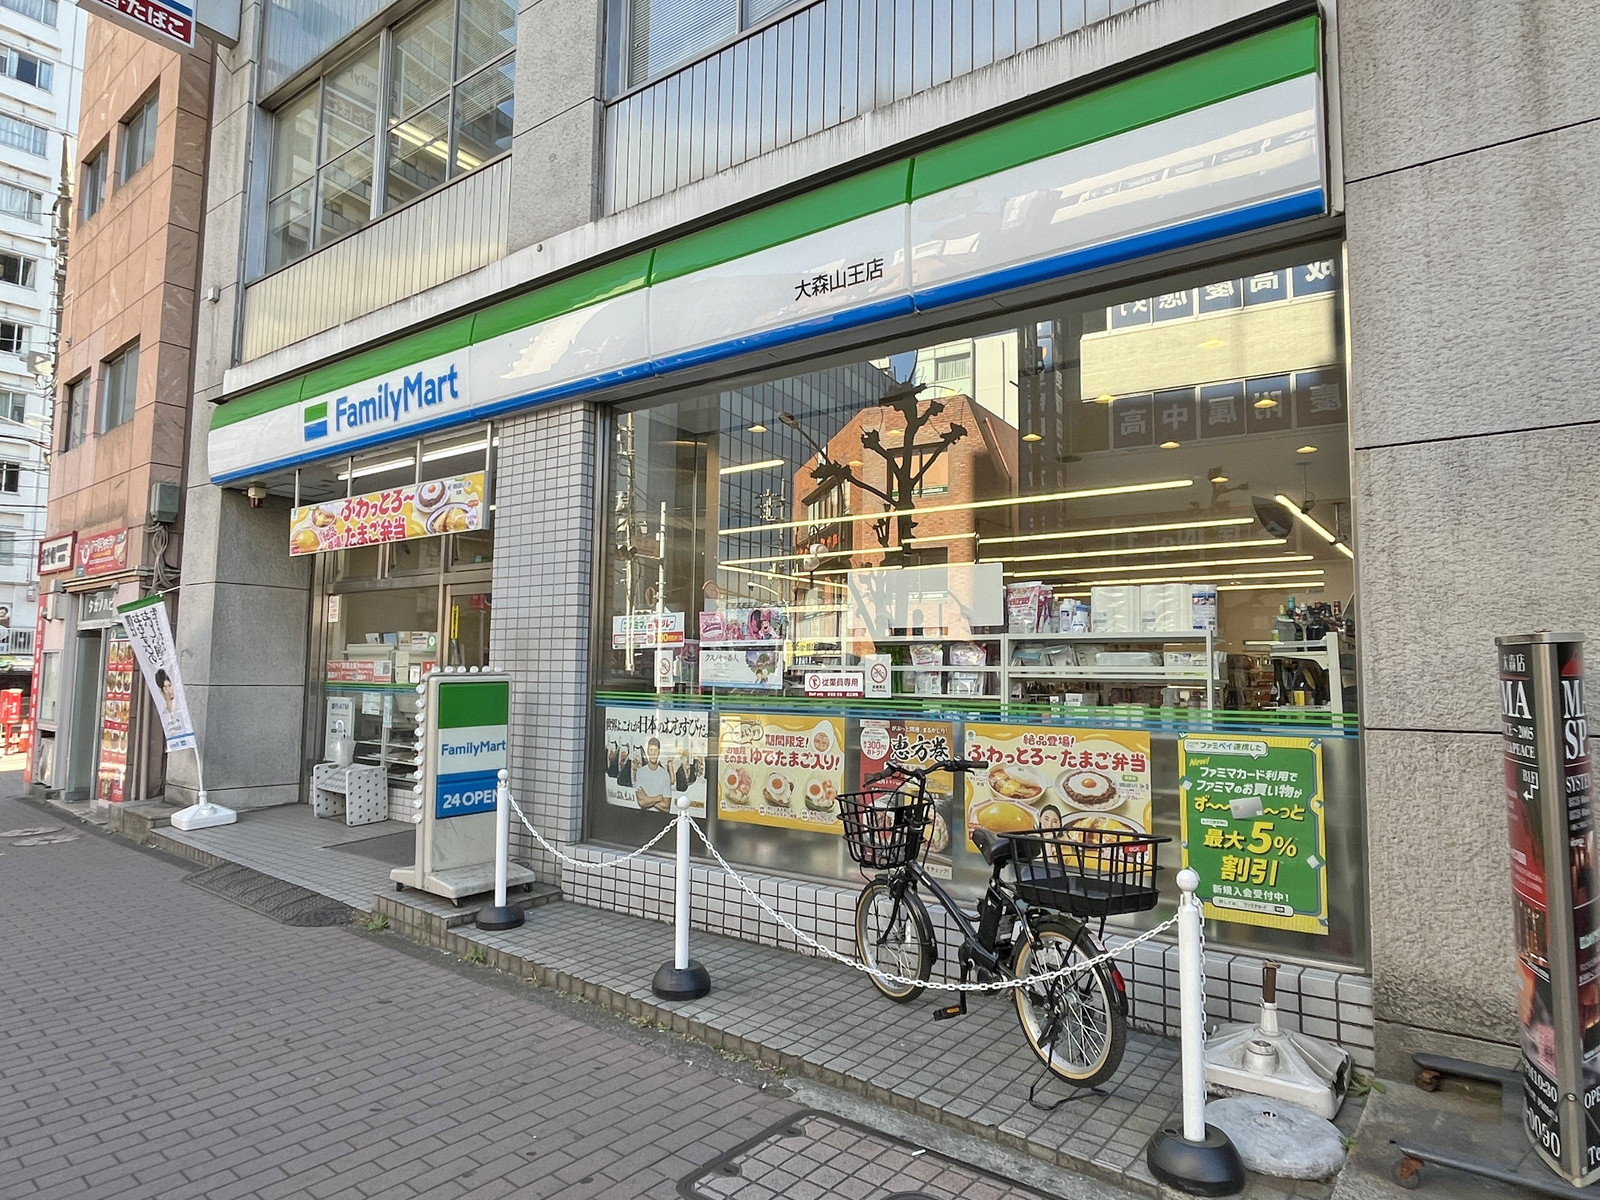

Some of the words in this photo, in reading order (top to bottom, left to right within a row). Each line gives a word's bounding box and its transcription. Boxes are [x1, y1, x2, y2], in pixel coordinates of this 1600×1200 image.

[794, 257, 884, 302] 大森山王店
[335, 363, 459, 432] FamilyMart
[344, 517, 406, 547] たまご弁当
[822, 678, 859, 687] 従業員専用
[441, 739, 506, 757] FamilyMart
[765, 733, 809, 748] 期間限定!
[891, 734, 949, 762] 恵方巻
[1023, 734, 1076, 748] 絶品登場!
[750, 748, 841, 771] ゆでたまご入り!
[1189, 756, 1210, 767] New!
[1199, 766, 1299, 782] ファミマカード利用で
[1196, 779, 1303, 799] ファミマのお買い物が
[443, 792, 461, 809] 24
[1221, 854, 1278, 886] 割引
[1212, 884, 1289, 902] 新規入会受付中!
